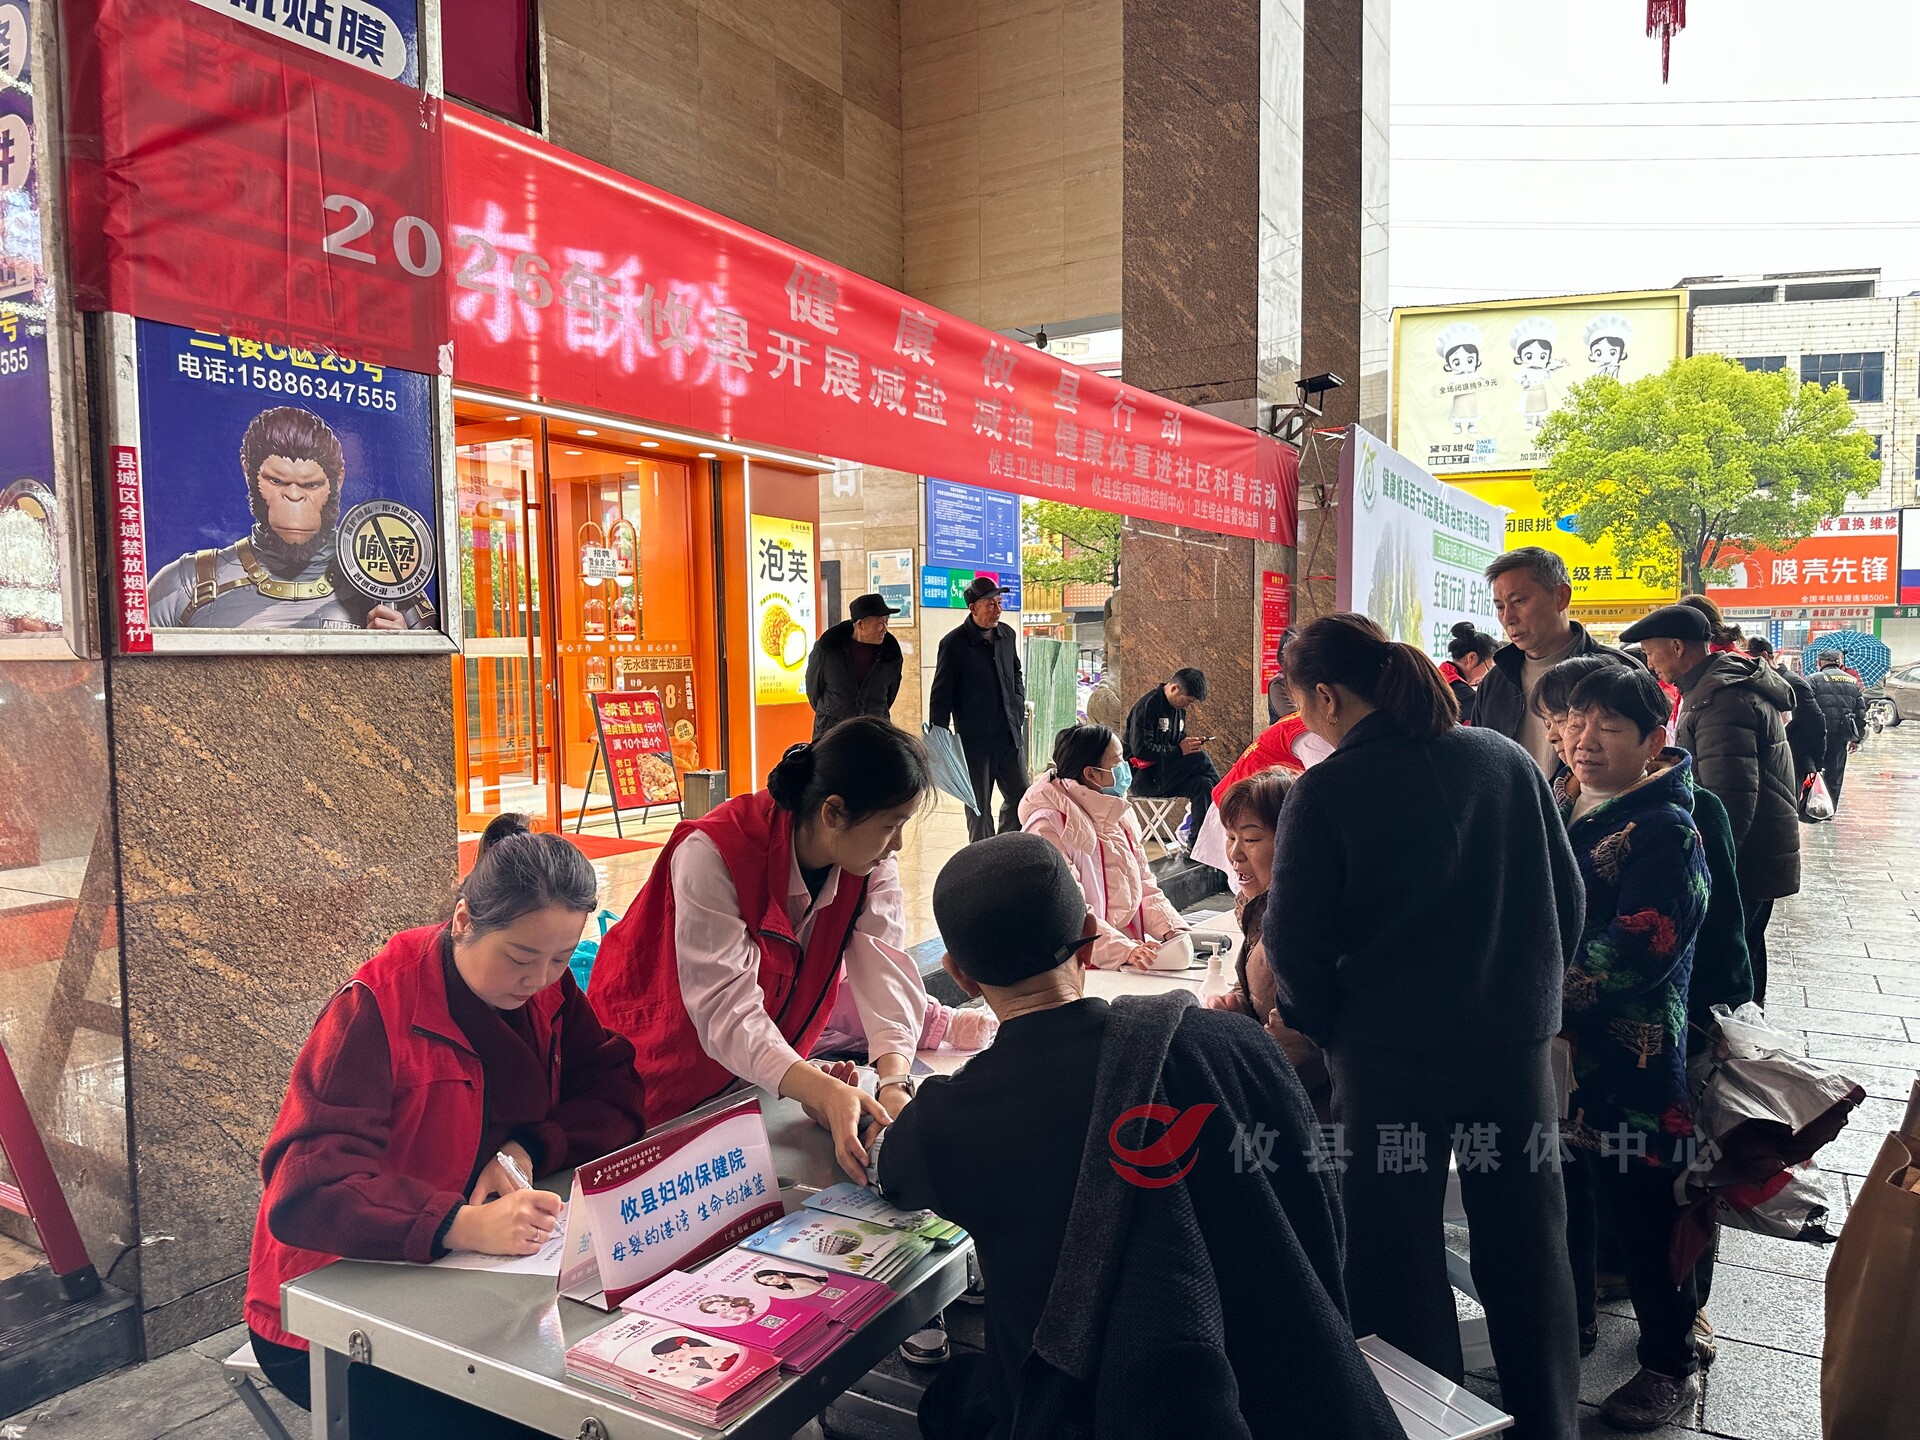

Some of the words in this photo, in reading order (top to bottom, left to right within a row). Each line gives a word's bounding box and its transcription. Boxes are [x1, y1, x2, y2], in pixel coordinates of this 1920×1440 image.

[785, 262, 1182, 447] 健康攸县行动
[178, 352, 397, 412] 电话:15886347555
[971, 395, 1034, 449] 减油
[1054, 416, 1277, 511] 健康体重进社区科普活动
[988, 447, 1076, 492] 攸县卫生健康局
[1838, 517, 1865, 531] 置换
[1870, 516, 1898, 530] 维修
[116, 452, 147, 642] 县城区全域禁放烟花爆竹
[758, 538, 809, 584] 泡芙
[1433, 571, 1465, 613] 全面行动
[1771, 556, 1889, 585] 膜壳先锋
[1801, 594, 1889, 604] 全国手机贴膜连锁500+
[623, 658, 692, 671] 无水蜂蜜牛奶蛋糕
[604, 702, 657, 717] 新品上市
[620, 1147, 747, 1225] 攸县妇幼保健院
[612, 1208, 690, 1263] 母婴的港湾
[696, 1172, 767, 1222] 生命的摇篮
